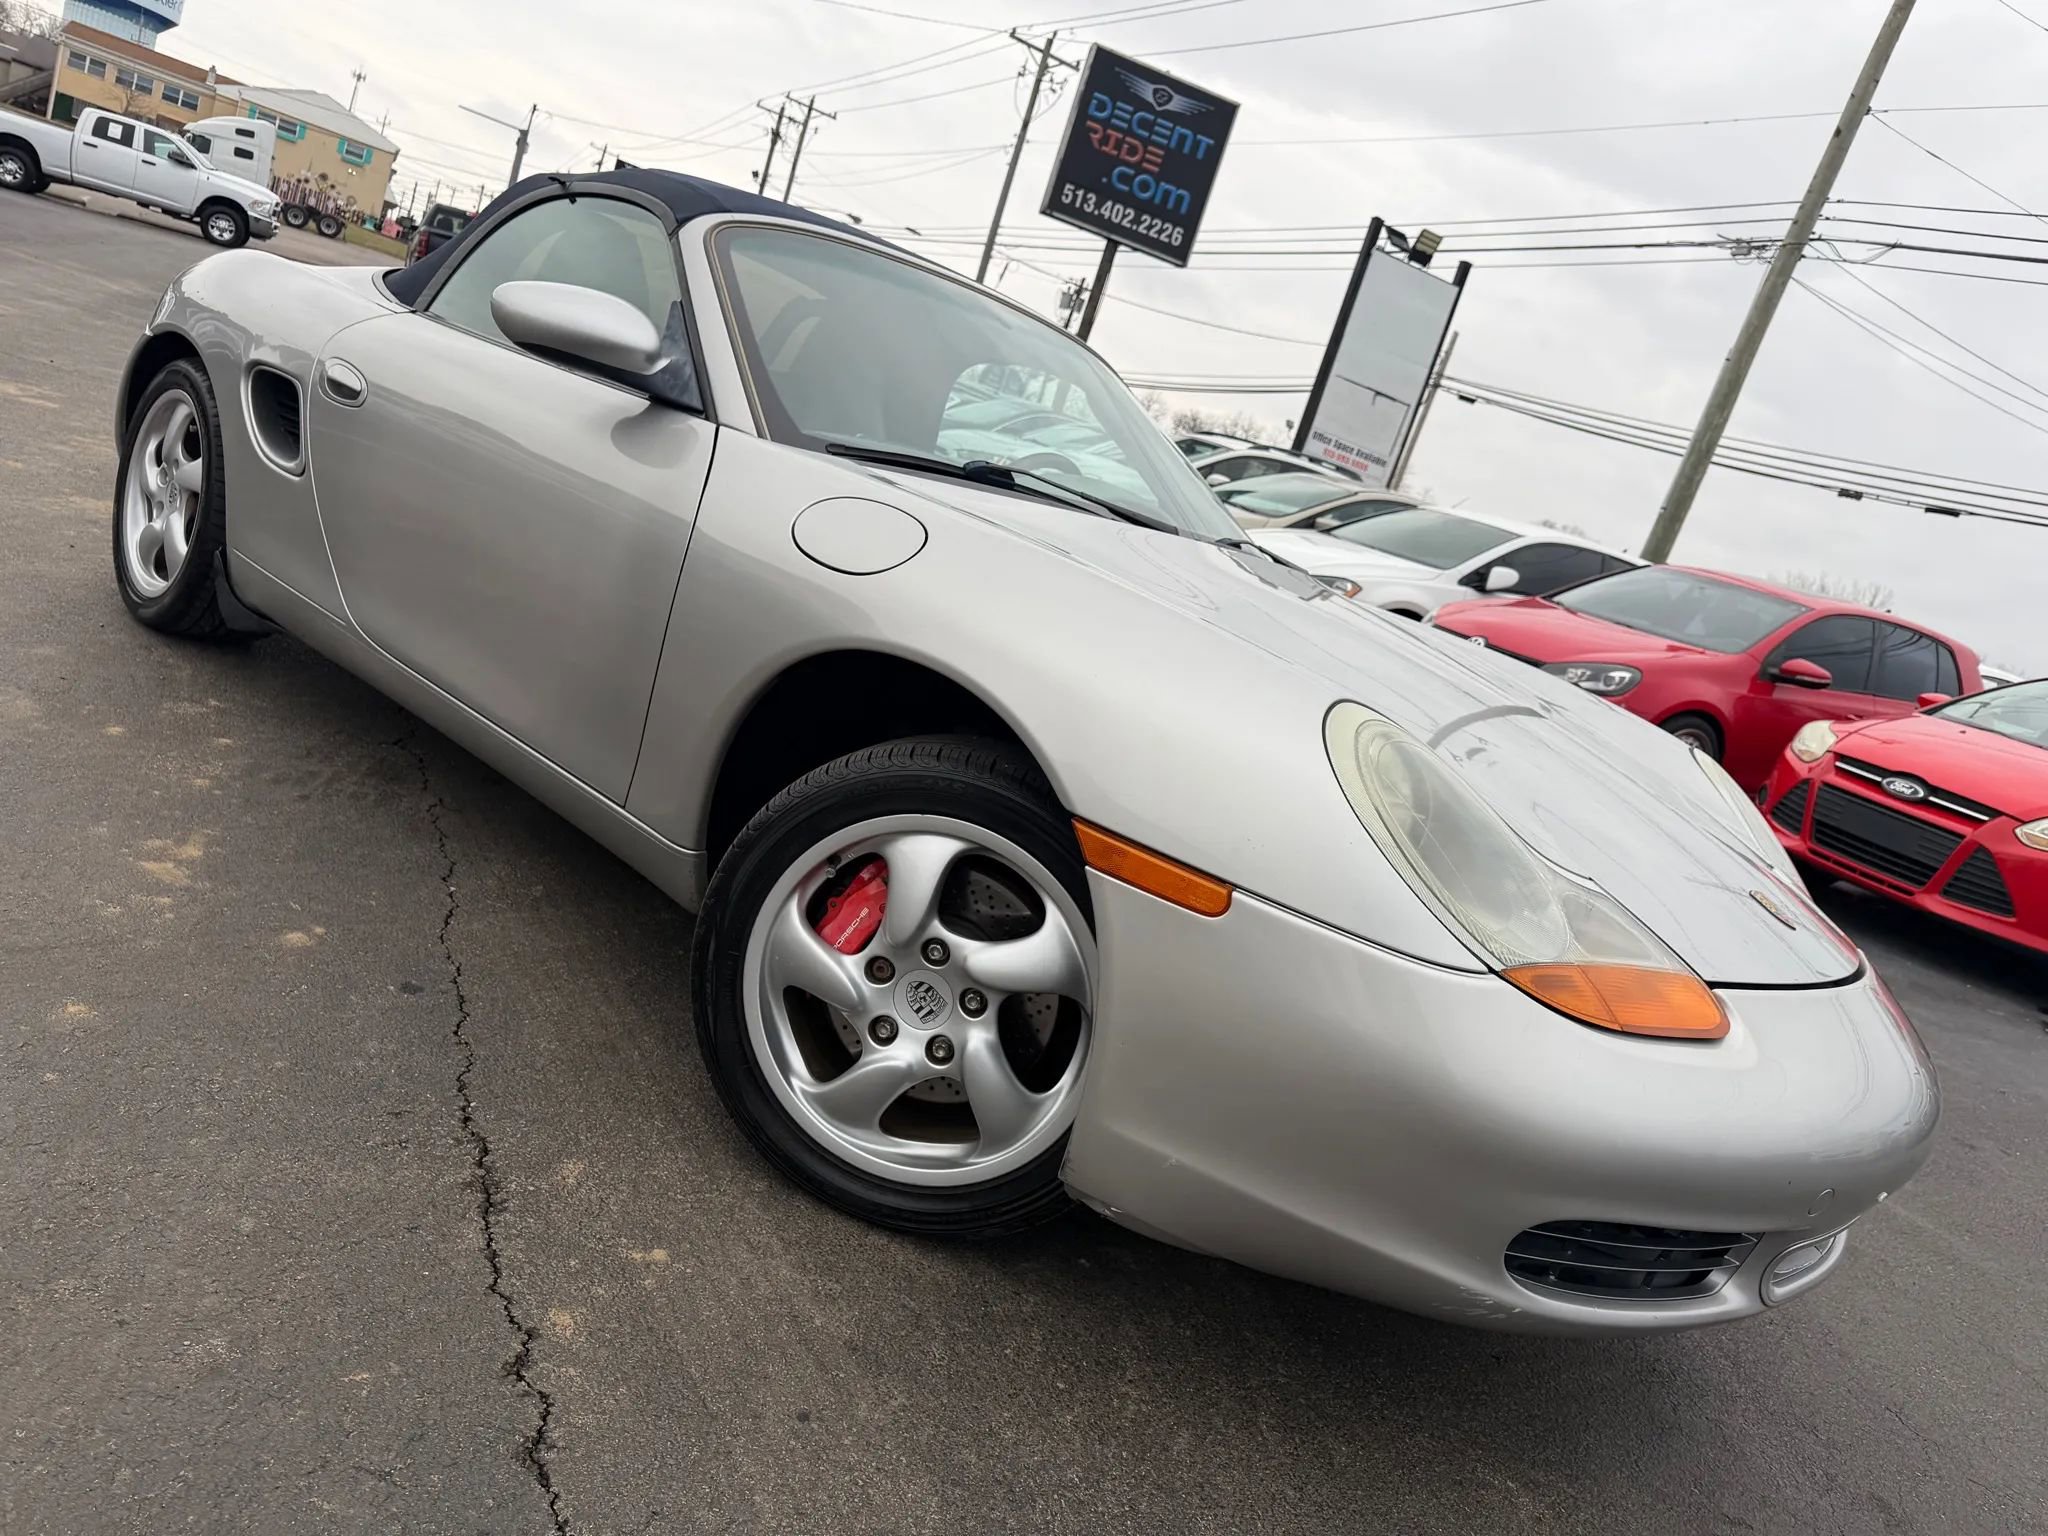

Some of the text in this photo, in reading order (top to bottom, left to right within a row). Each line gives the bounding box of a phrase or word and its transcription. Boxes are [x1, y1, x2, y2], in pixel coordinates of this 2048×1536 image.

[1086, 121, 1164, 172] RIDE
[1088, 92, 1214, 159] DECENT
[1061, 183, 1184, 247] 513.402.2226
[1312, 431, 1331, 446] Office
[1333, 439, 1353, 454] Space
[1356, 449, 1387, 467] Available
[832, 906, 869, 950] PORSCHE
